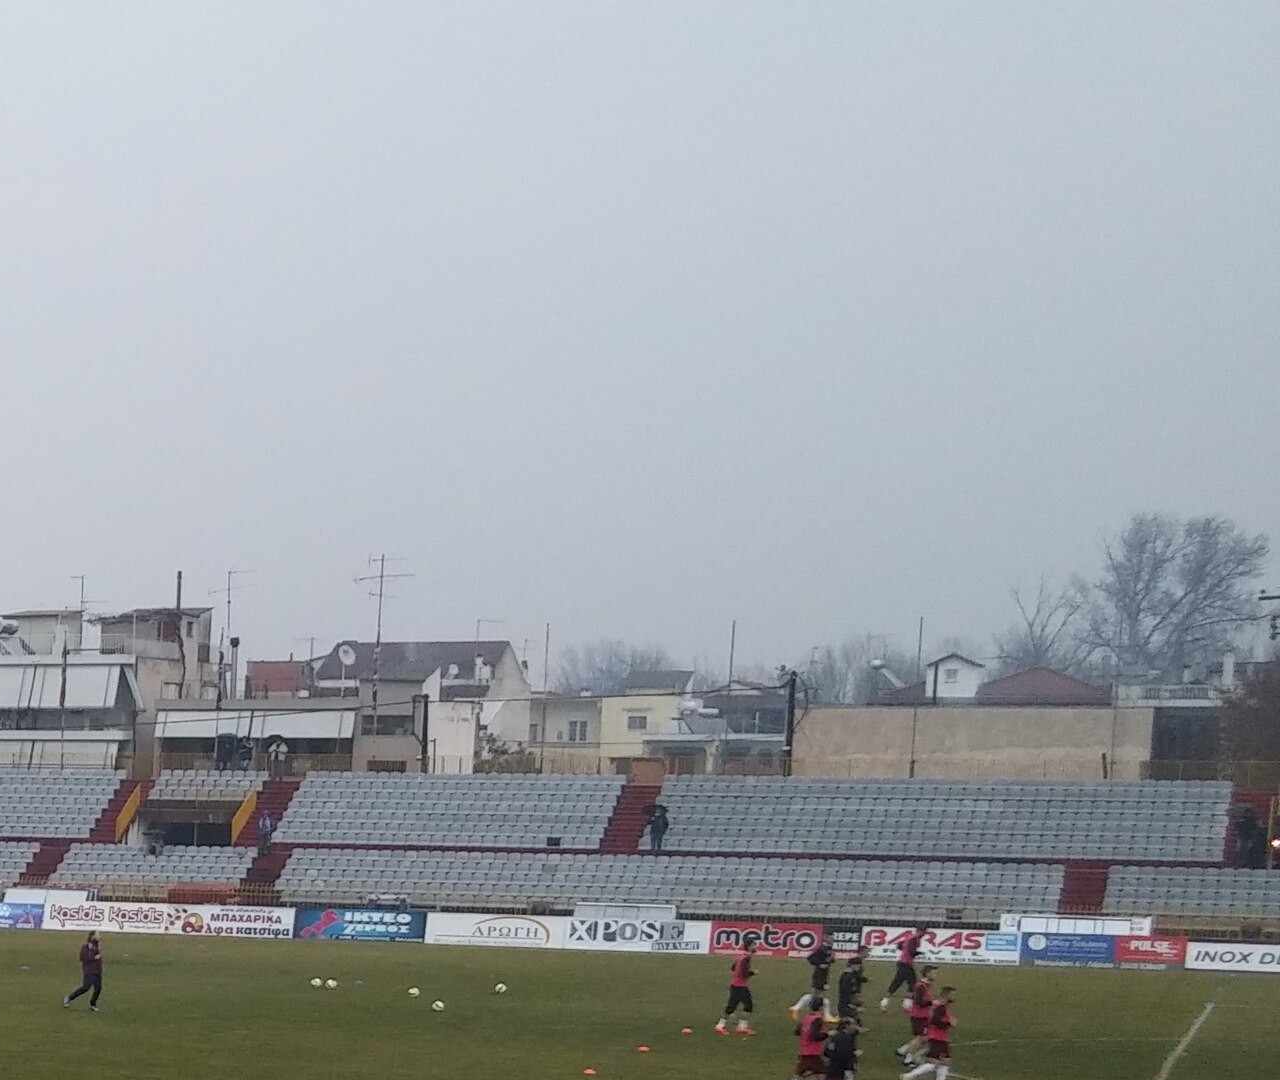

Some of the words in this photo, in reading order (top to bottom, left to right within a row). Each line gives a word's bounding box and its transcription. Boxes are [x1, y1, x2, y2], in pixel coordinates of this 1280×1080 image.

[210, 913, 282, 925] ΜΠΑΧΑΡΙΚΑ
[472, 925, 539, 938] ΑΡΩΓΗ
[569, 920, 685, 942] XPOSE
[714, 925, 817, 950] metro
[1194, 950, 1254, 963] INOX
